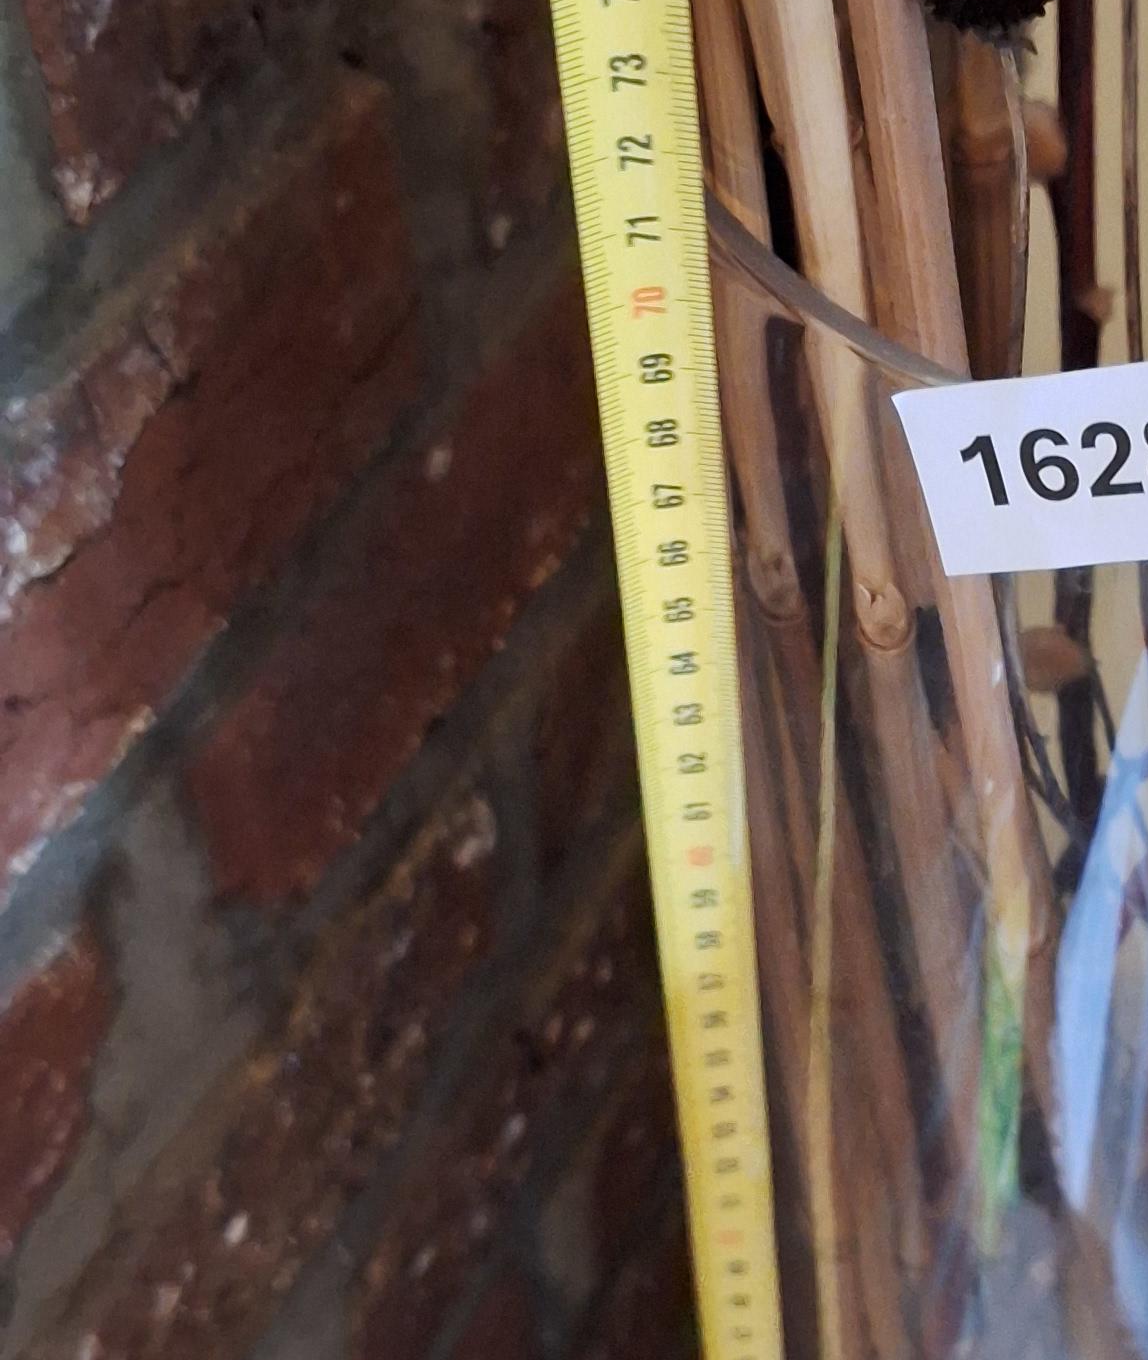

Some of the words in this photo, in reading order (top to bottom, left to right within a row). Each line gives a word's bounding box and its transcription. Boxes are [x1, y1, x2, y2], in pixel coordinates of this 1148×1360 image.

[609, 53, 647, 92] 73
[617, 135, 654, 170] 72
[625, 216, 661, 245] 71
[631, 286, 667, 318] 70
[639, 353, 673, 384] 69
[646, 418, 679, 448] 68
[652, 484, 685, 509] 67
[658, 540, 689, 567] 66
[664, 597, 695, 624] 65
[669, 651, 699, 676] 64
[673, 702, 704, 727] 63
[677, 752, 709, 775] 62
